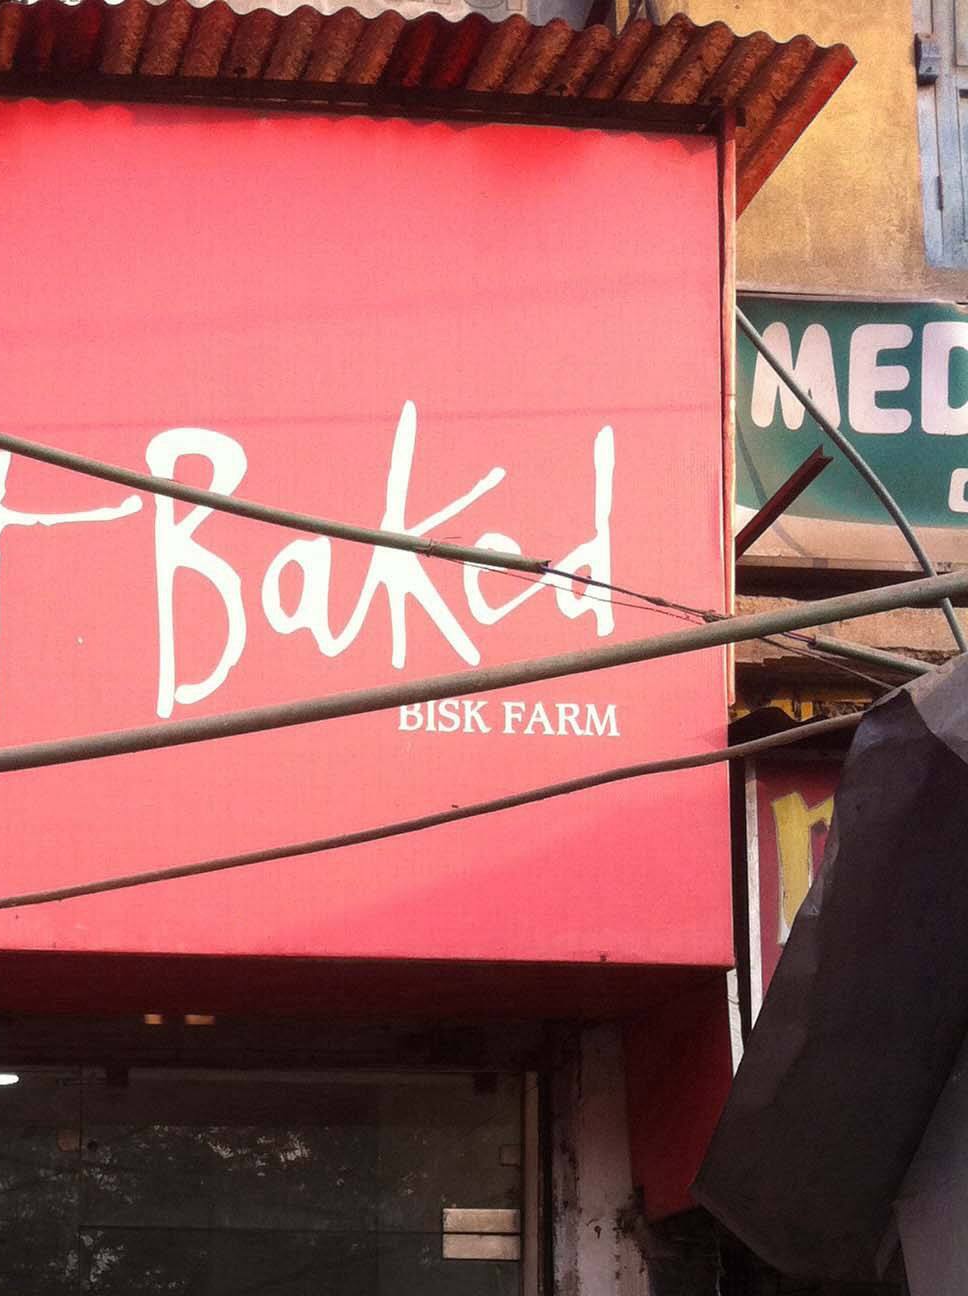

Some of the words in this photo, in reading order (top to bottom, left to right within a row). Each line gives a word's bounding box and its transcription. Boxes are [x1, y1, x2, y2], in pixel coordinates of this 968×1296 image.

[145, 399, 616, 719] Baked
[398, 700, 492, 733] BISK
[503, 701, 620, 736] FARM
